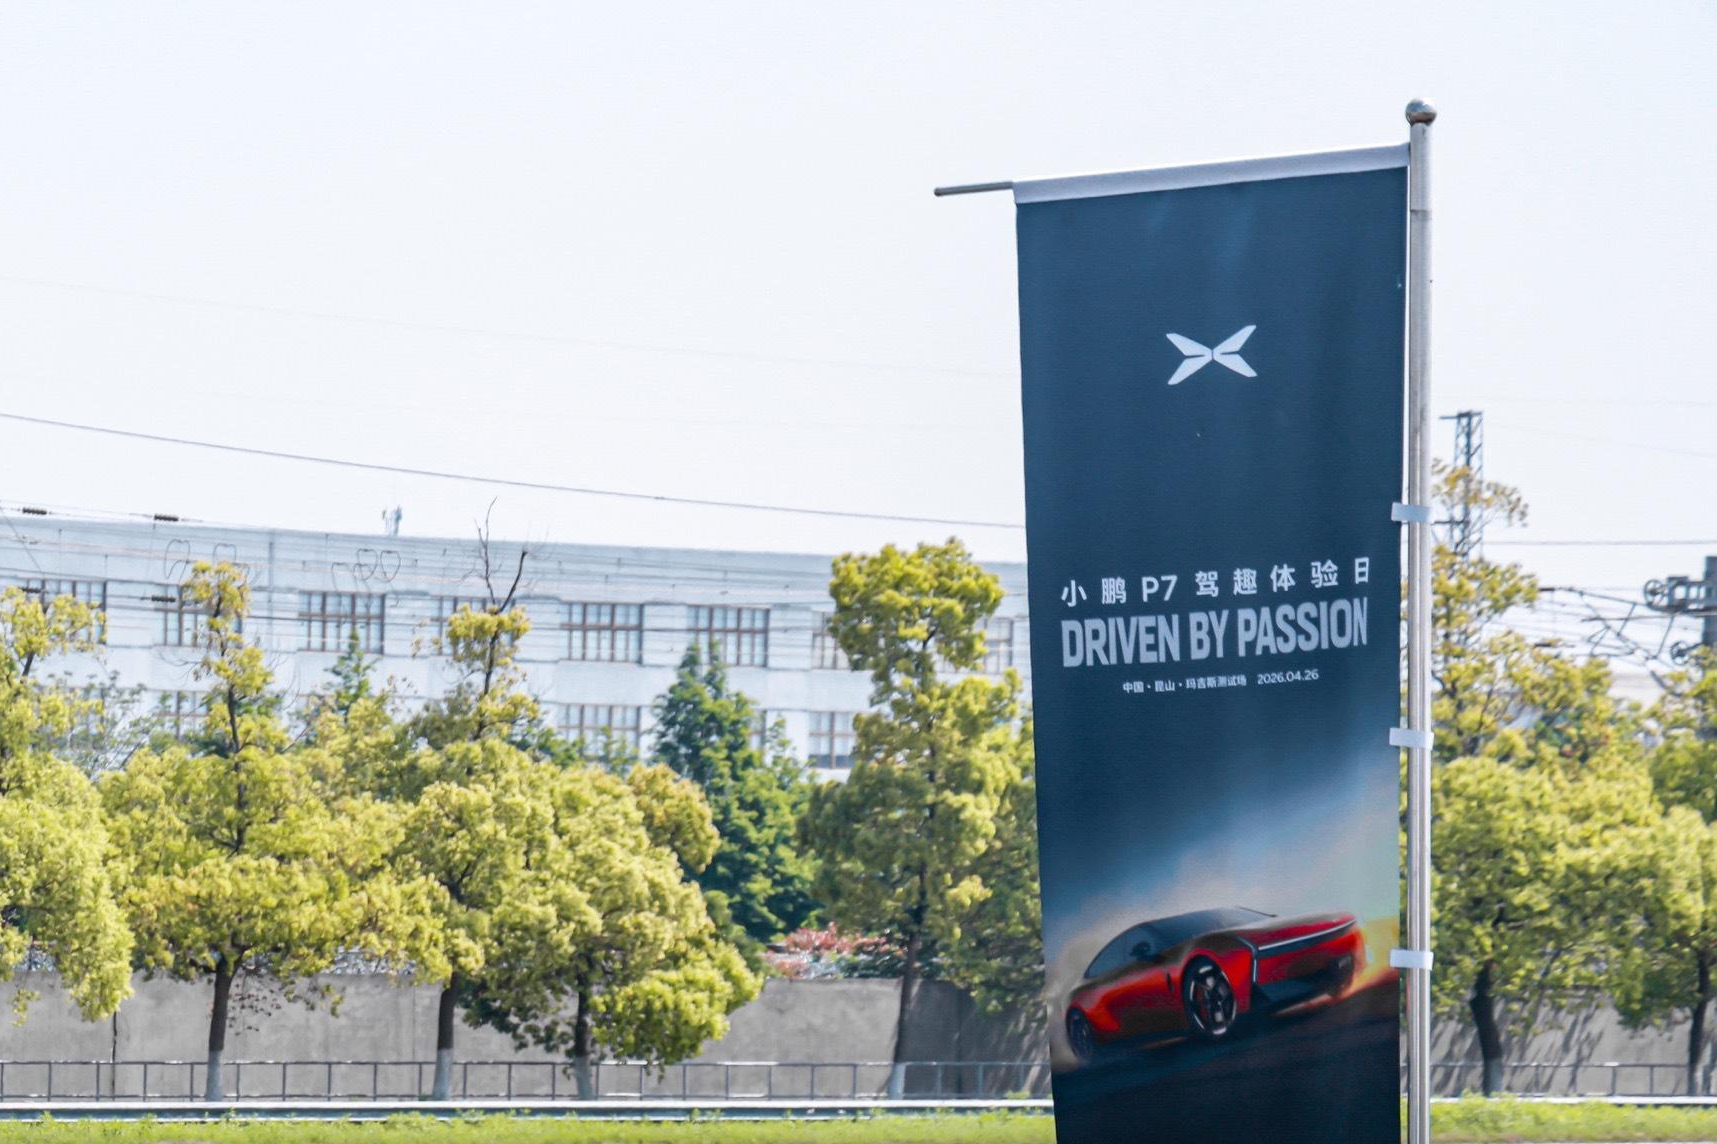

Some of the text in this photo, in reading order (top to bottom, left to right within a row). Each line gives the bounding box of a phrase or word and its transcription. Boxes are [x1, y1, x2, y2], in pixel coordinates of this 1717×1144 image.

[1061, 556, 1370, 607] 小鹏 P7 驾趣体验日
[1060, 596, 1369, 667] DRIVEN BY PASSION
[1257, 668, 1320, 685] 2026.04.26
